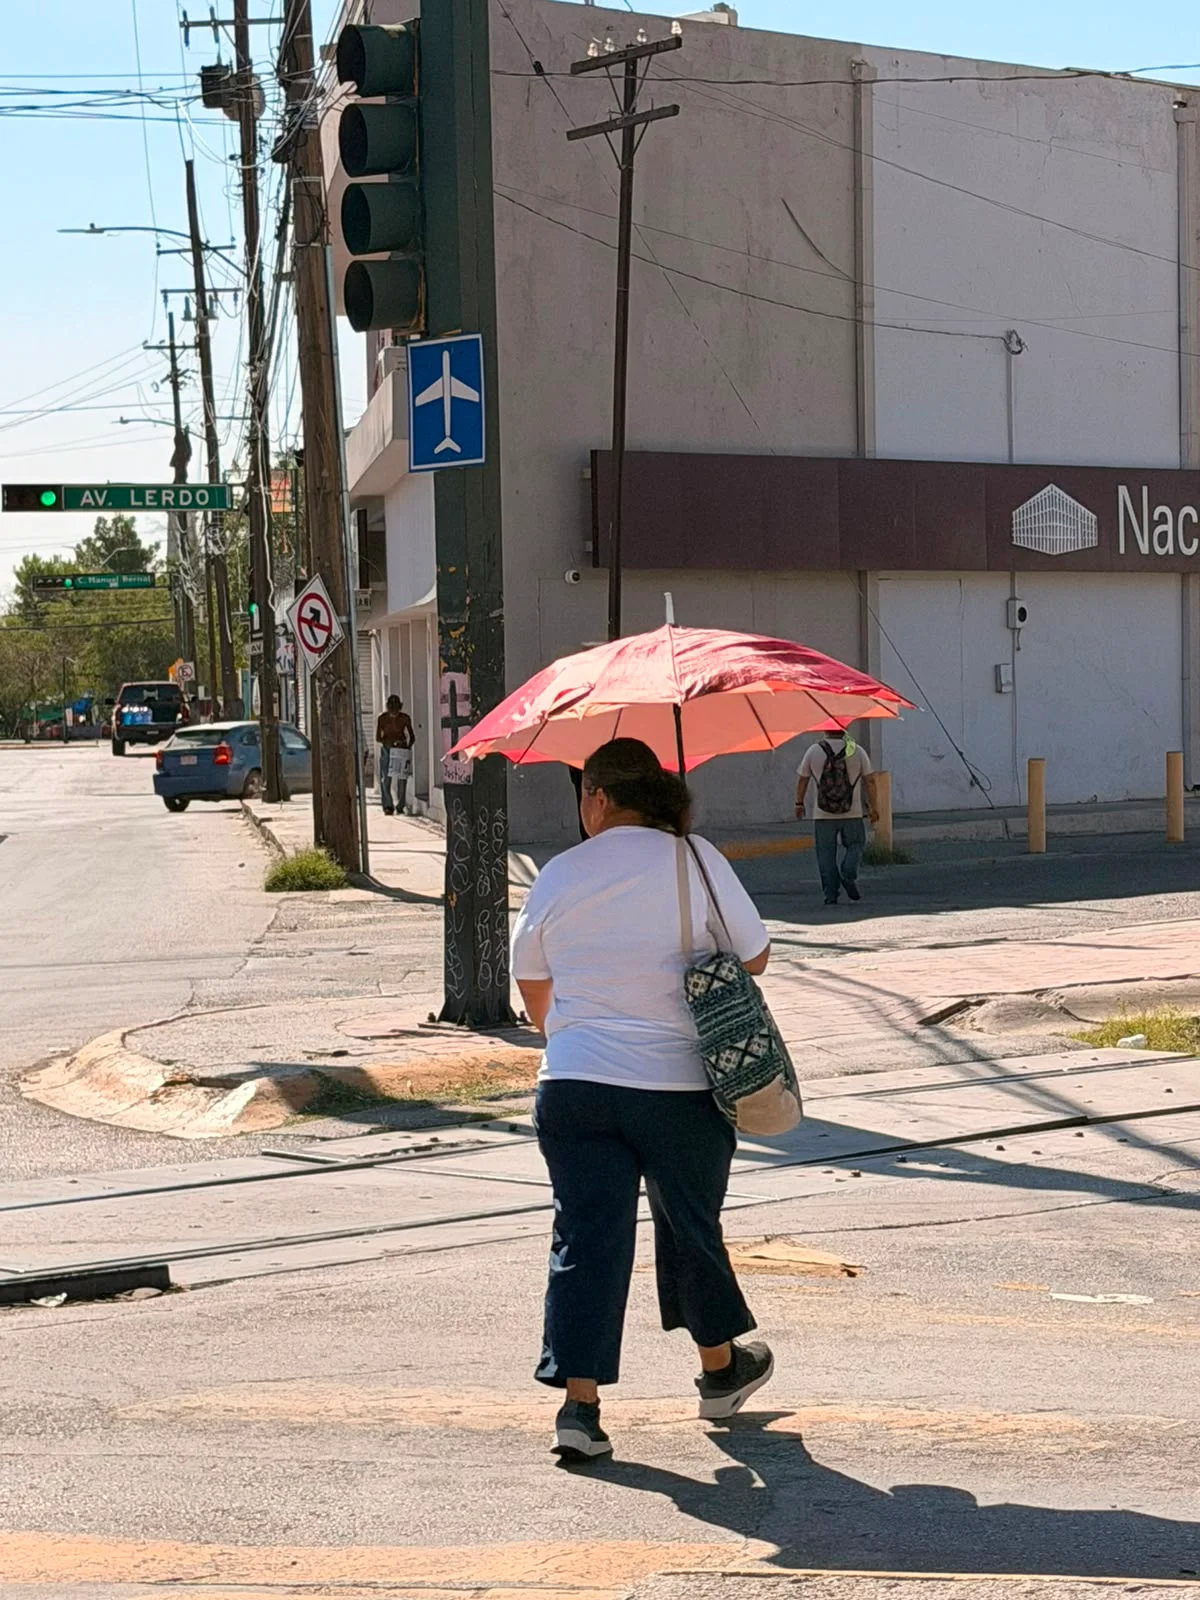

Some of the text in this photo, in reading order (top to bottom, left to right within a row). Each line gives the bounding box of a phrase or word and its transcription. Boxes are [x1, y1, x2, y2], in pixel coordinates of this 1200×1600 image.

[80, 489, 209, 506] AV. LERDO
[1117, 484, 1199, 556] Nac
